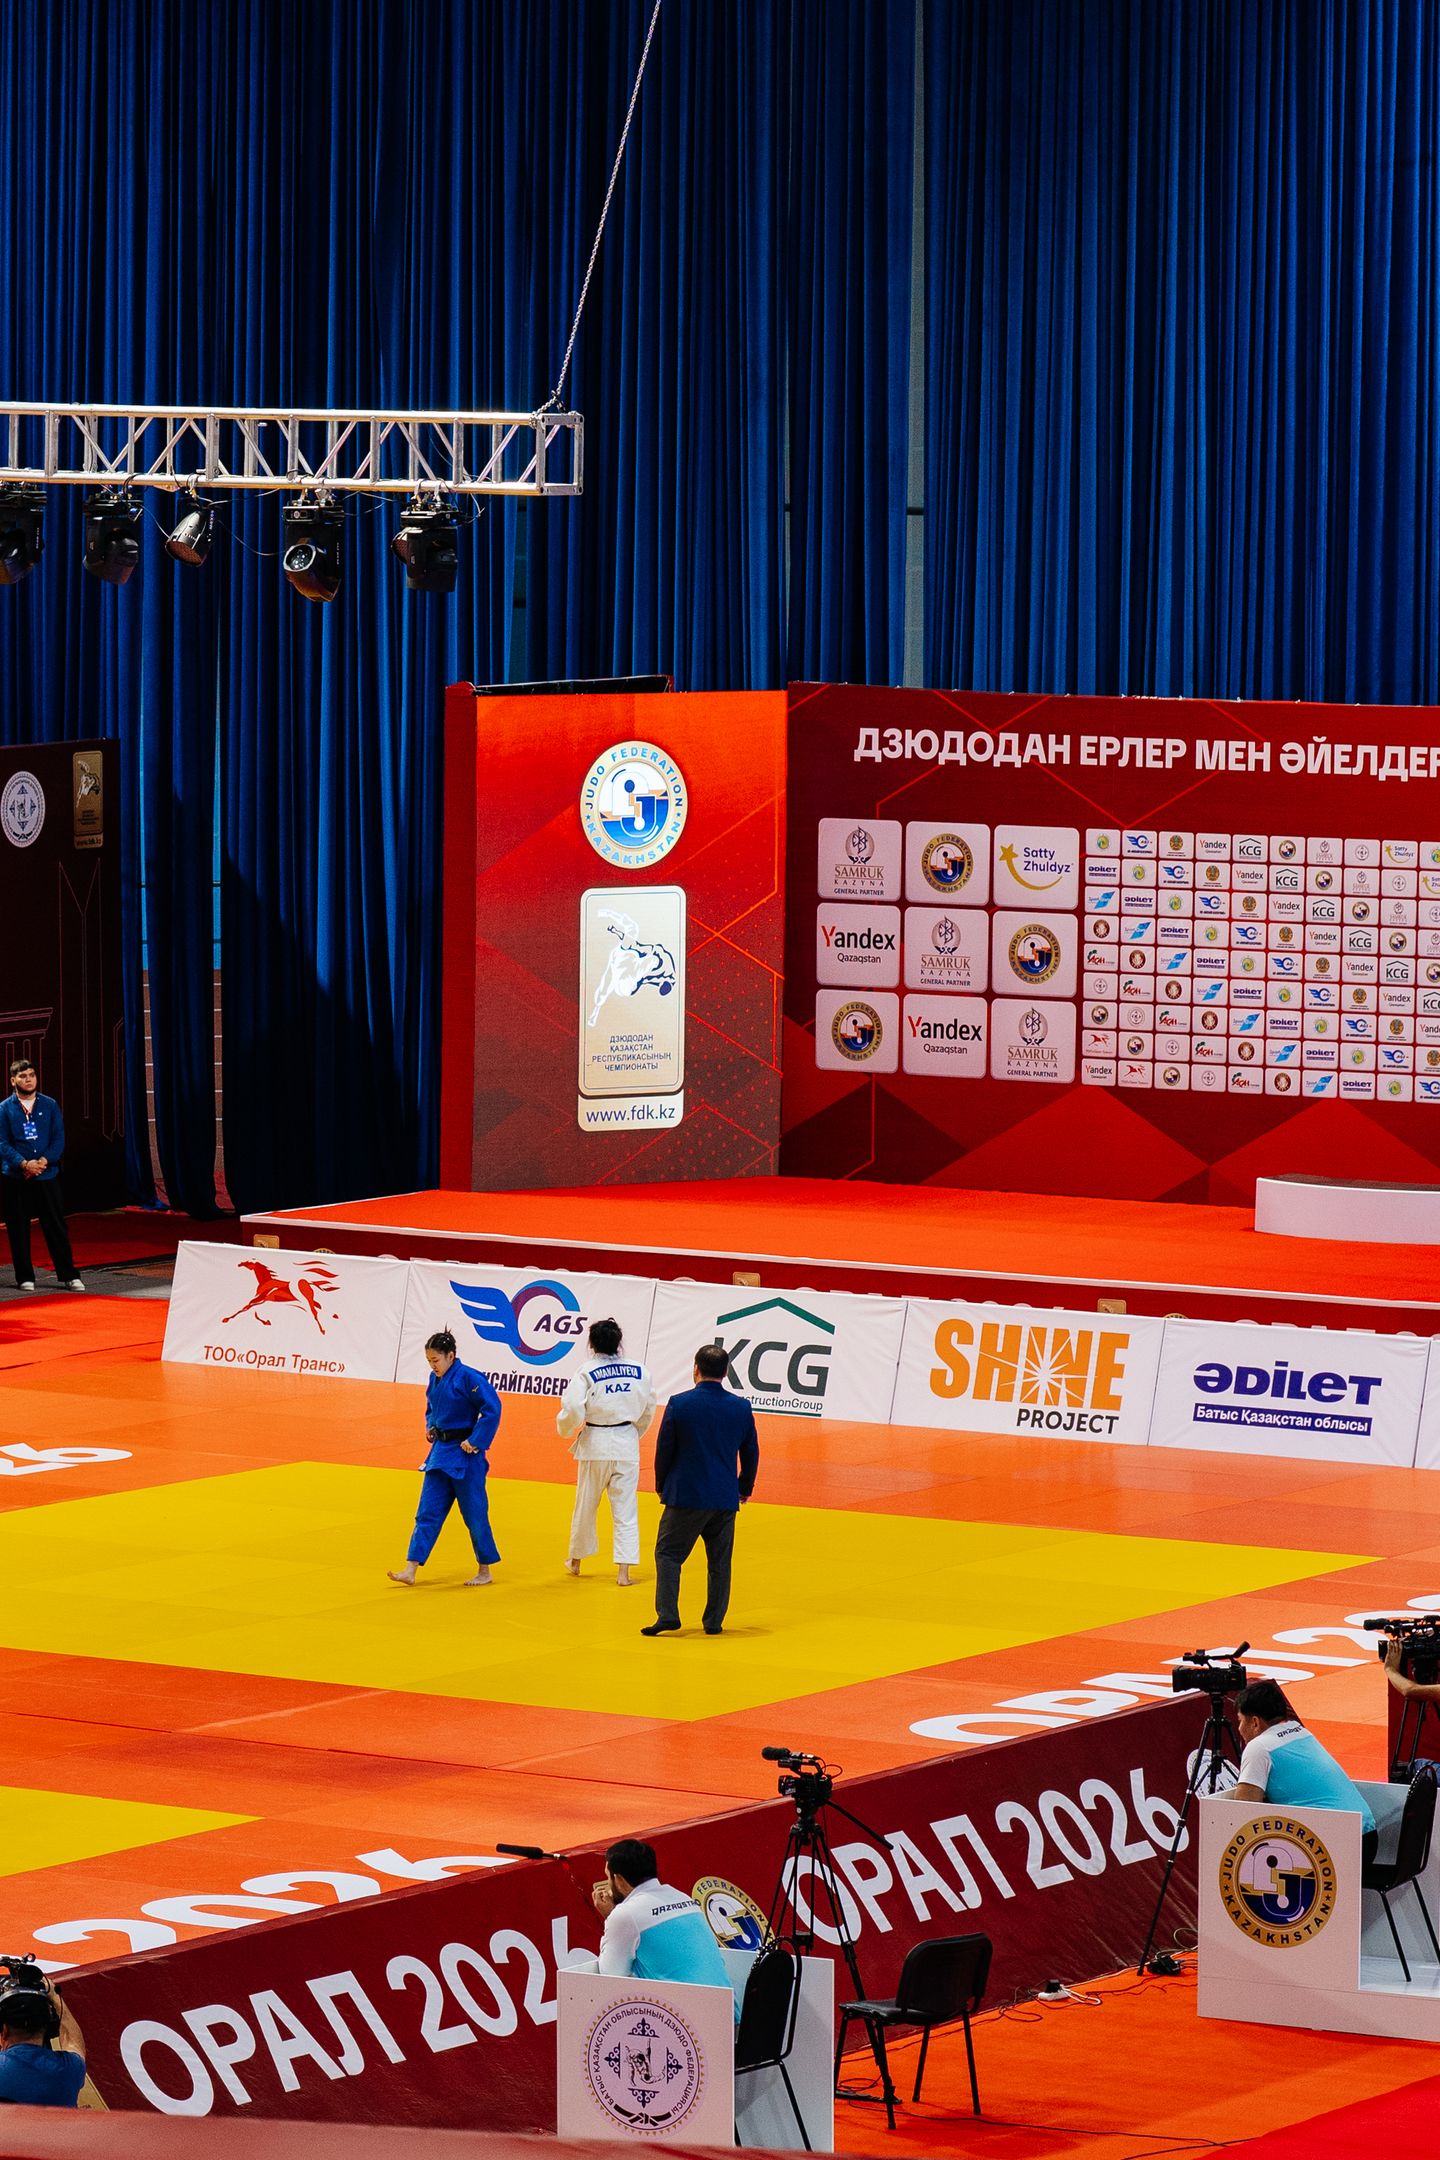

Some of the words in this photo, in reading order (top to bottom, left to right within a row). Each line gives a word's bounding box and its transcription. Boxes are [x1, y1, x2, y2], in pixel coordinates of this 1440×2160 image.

[853, 727, 1071, 768] ДЗЮДОДАН
[1079, 734, 1187, 769] ЕРЛЕР
[1195, 739, 1271, 772] МЕН
[585, 765, 605, 809] JUDO
[610, 746, 683, 807] FEDERATION
[586, 821, 681, 864] KAZAKHSTAN
[1200, 840, 1227, 849] Yandex
[1023, 846, 1055, 861] Satty
[1239, 846, 1261, 856] KCG
[834, 866, 884, 879] SAMRUK
[1023, 860, 1071, 875] Zhuldyz
[1236, 870, 1263, 880] Yandex
[1276, 876, 1298, 887] KCG
[834, 879, 884, 887] KAZYNA
[1273, 901, 1300, 911] Yandex
[1312, 907, 1335, 917] KCG
[821, 925, 896, 950] Yandex
[1309, 931, 1337, 941] Yandex
[1349, 937, 1372, 948] KCG
[837, 952, 882, 964] Qazaqstan
[921, 957, 971, 969] SAMRUK
[920, 969, 971, 977] KAZYNA
[1346, 962, 1374, 972] Yandex
[1386, 969, 1409, 979] KCG
[1383, 993, 1411, 1003] Yandex
[908, 1016, 983, 1041] Yandex
[609, 1034, 654, 1043] ДЗЮДОДАН
[609, 1044, 654, 1053] ҚАЗАҚСТАН
[923, 1043, 968, 1055] Qazaqstan
[1008, 1047, 1058, 1060] SAMRUK
[592, 1052, 672, 1063] РЕСПУБЛИКАСЫНЫҢ
[604, 1063, 658, 1072] ЧЕМПИОНАТЫ
[1007, 1061, 1058, 1069] KAZYNA
[1085, 1066, 1113, 1075] Yandex
[586, 1104, 675, 1123] www.fdk.kz
[533, 1313, 588, 1335] AGS
[203, 1345, 286, 1369] ТОО«Орал
[292, 1354, 346, 1373] Транс»
[929, 1318, 1131, 1411] SHINE
[714, 1336, 832, 1397] KCG
[484, 1370, 572, 1397] САЙГАЗСЕР
[605, 1383, 631, 1394] KAZ
[1016, 1408, 1120, 1434] PROJECT
[1196, 1406, 1239, 1421] Батыс
[1241, 1409, 1312, 1428] Қазақстан
[1314, 1416, 1368, 1432] облысы
[782, 1814, 1016, 1946] ОРАЛ
[995, 1767, 1190, 1890] 2026
[1223, 1834, 1246, 1880] JUDO
[1252, 1820, 1333, 1891] FEDERATION
[697, 1879, 764, 1922] FEDERATION
[1224, 1894, 1331, 1944] KAZAKHSTAN
[611, 2007, 665, 2024] ОБЛЫСЫНЫҢ
[664, 2017, 688, 2048] ДЗЮДО
[119, 1970, 406, 2117] ОРАЛ
[671, 2049, 695, 2115] ФЕДЕРАЦИЯСЫ
[595, 2075, 614, 2106] БАТЫС
